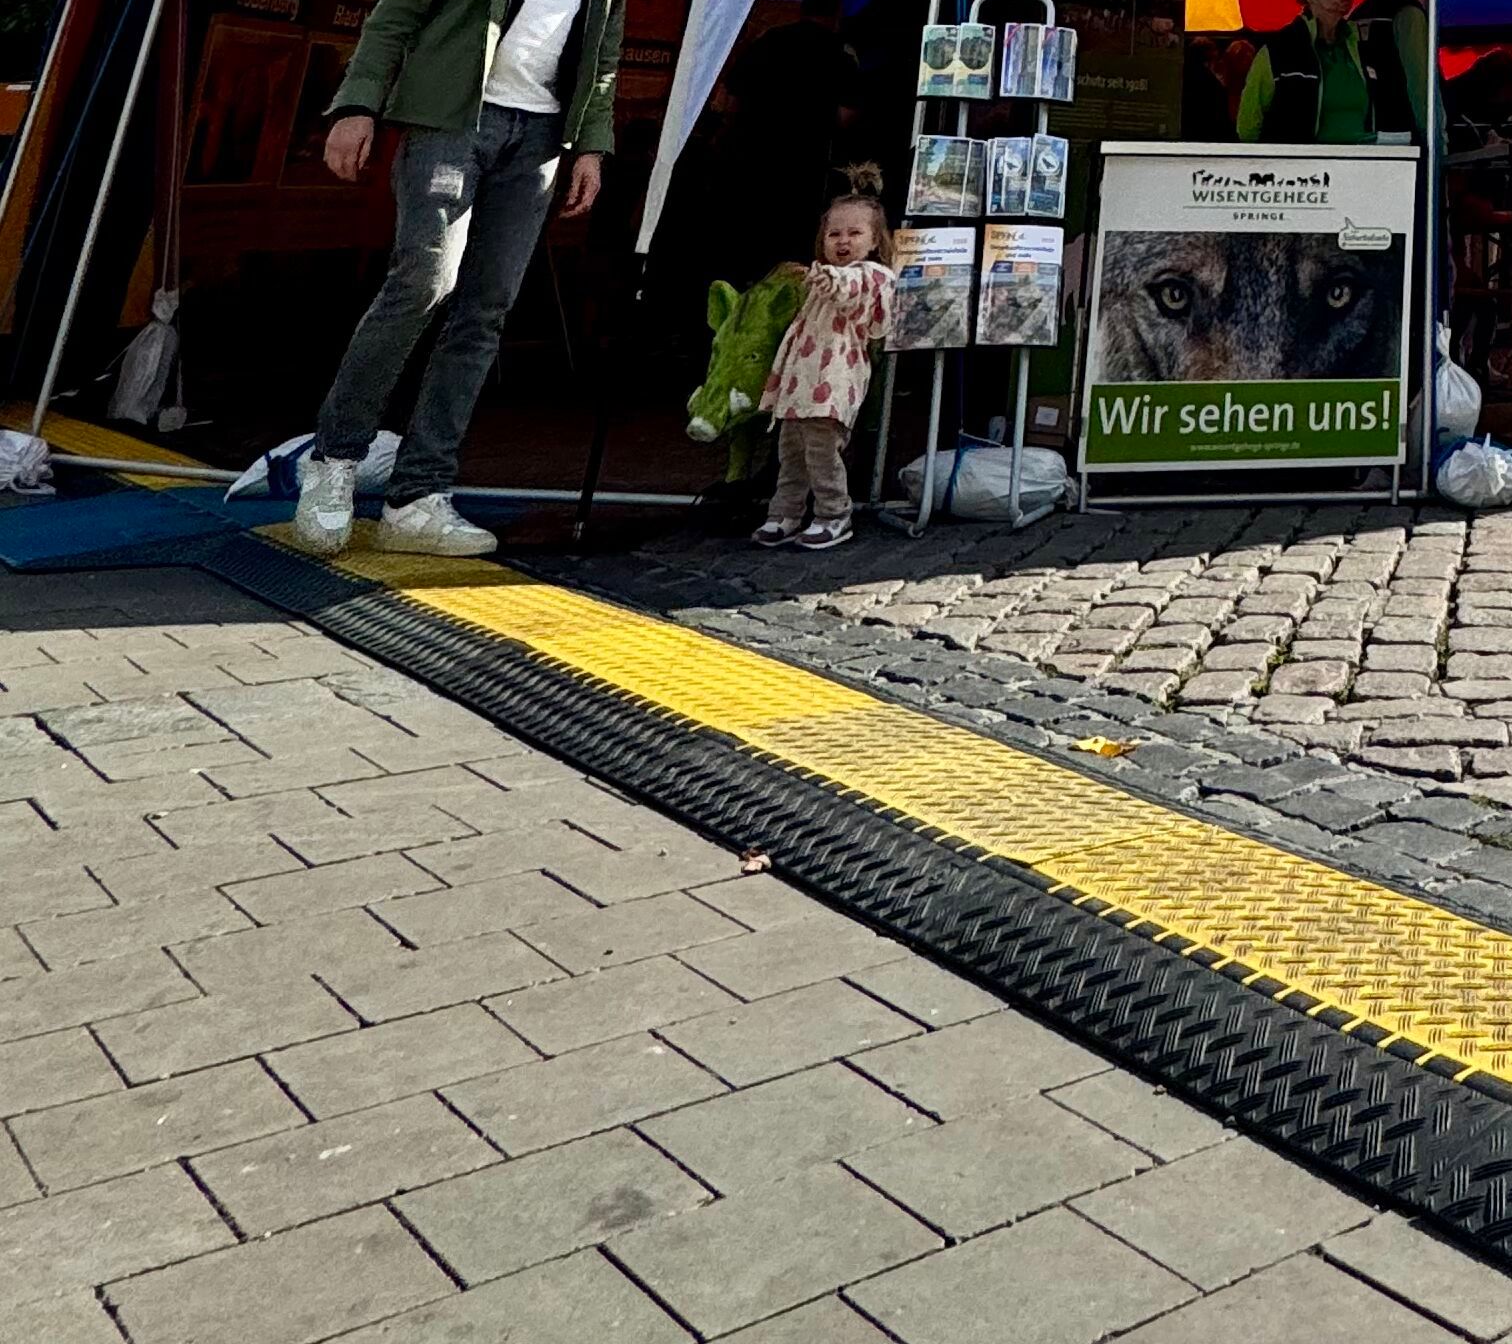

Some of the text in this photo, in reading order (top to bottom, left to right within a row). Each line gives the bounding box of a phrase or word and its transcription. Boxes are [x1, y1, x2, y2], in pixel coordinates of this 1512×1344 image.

[1192, 189, 1329, 204] WISENTGEHEGE
[1232, 212, 1285, 221] SPRINGE
[1098, 390, 1391, 435] Wir sehen uns!
